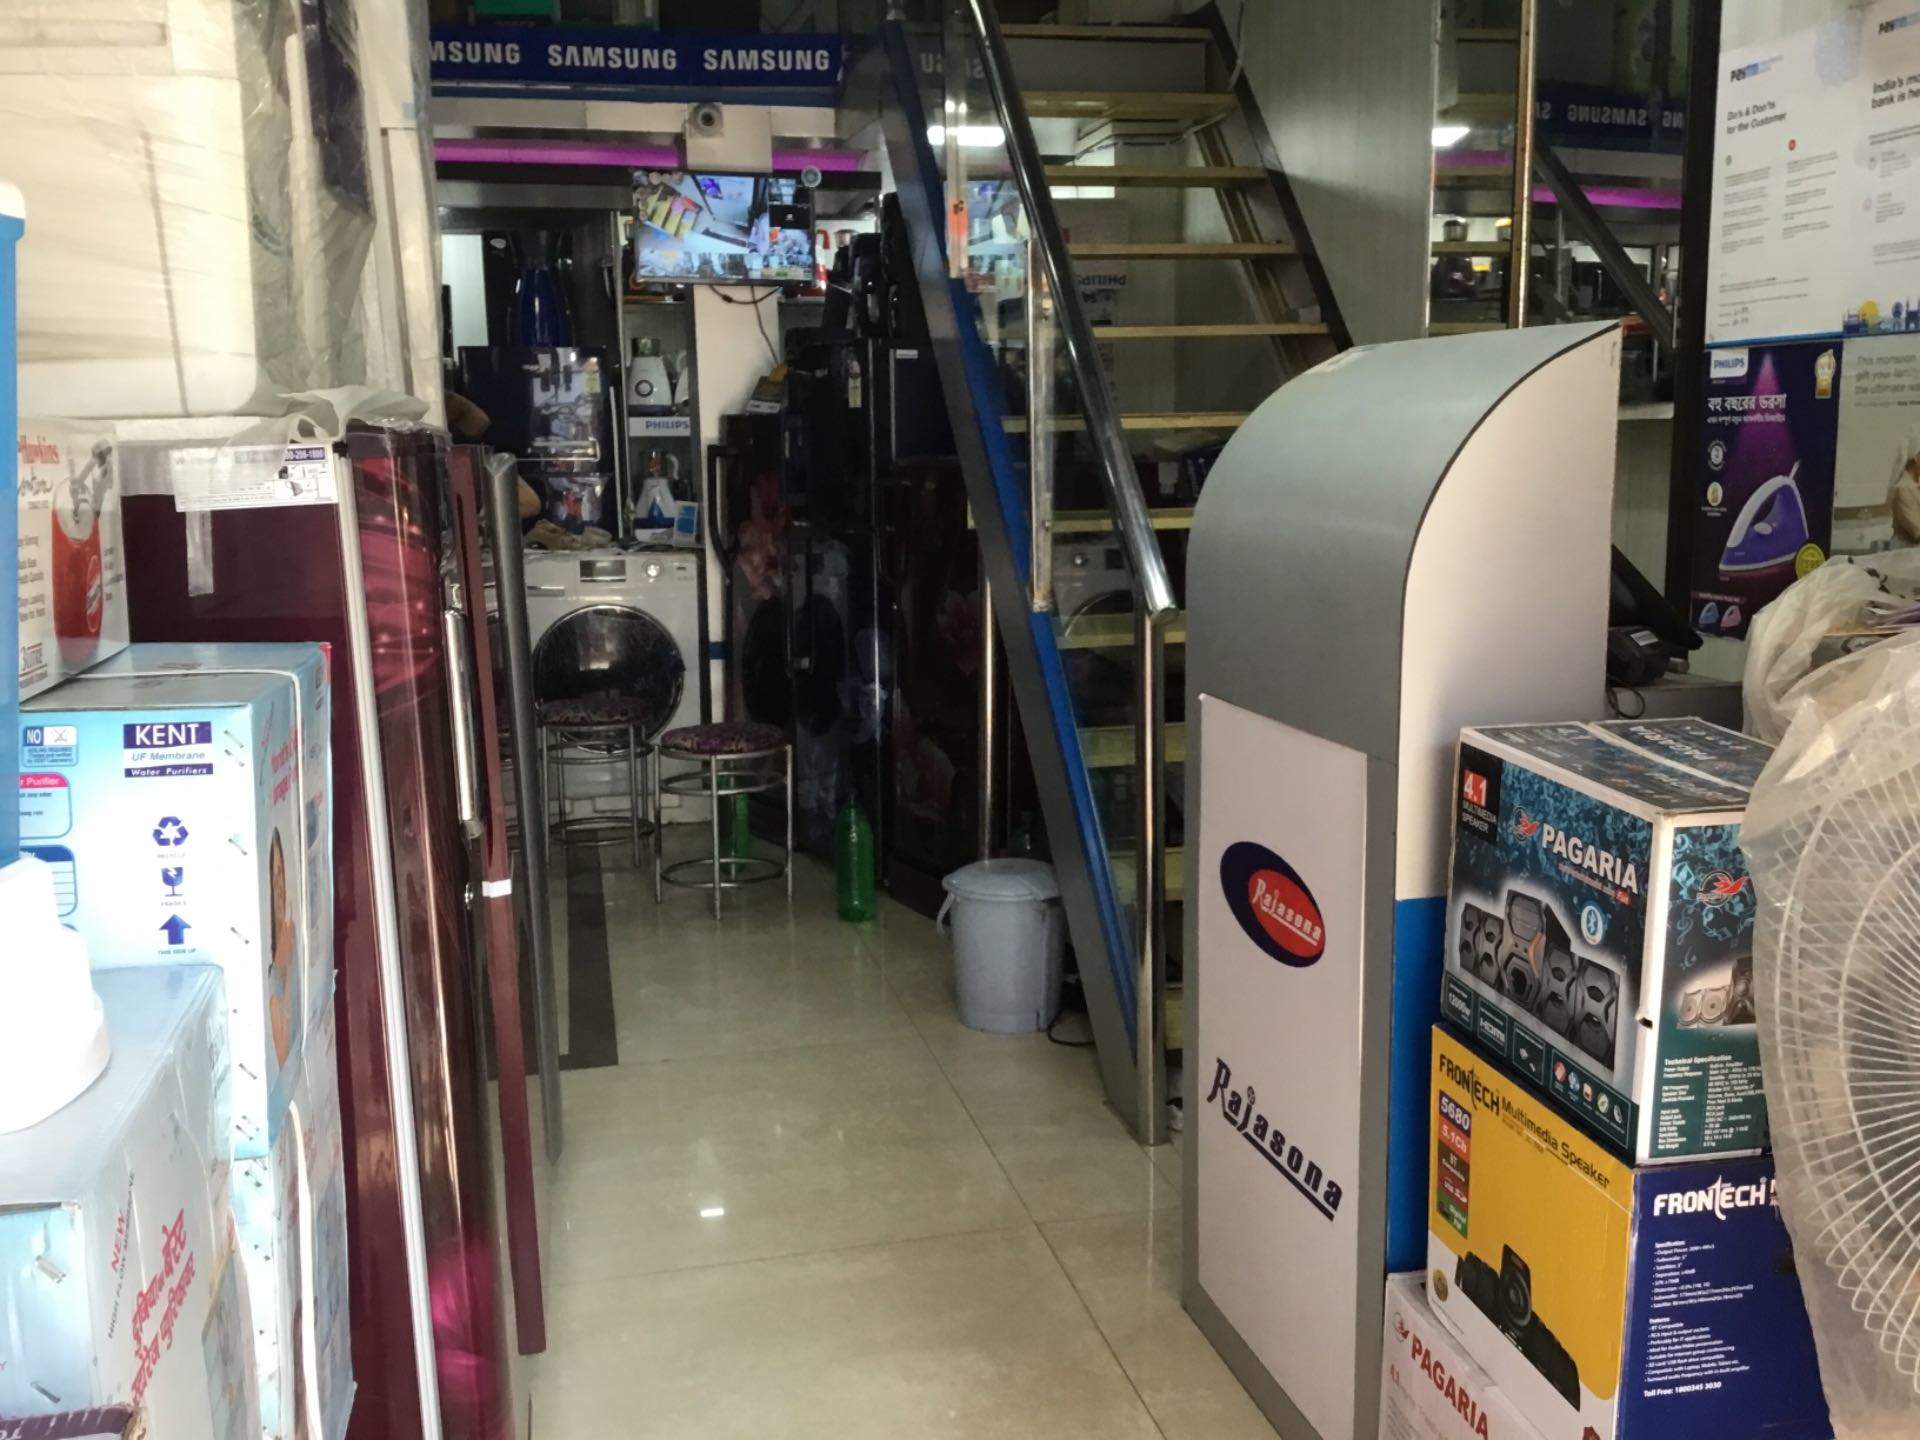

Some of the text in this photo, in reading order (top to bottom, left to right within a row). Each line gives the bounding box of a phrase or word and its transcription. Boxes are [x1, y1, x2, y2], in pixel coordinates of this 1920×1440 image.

[430, 40, 830, 72] MSUNG SAMSUNG SAMSUNG
[1871, 95, 1895, 109] bank
[1751, 112, 1787, 128] Customer
[1713, 357, 1745, 370] PHILIPS
[645, 420, 689, 430] PHILIPS
[26, 728, 42, 744] NO
[135, 723, 200, 746] KENT
[132, 751, 205, 762] UF Membrane
[26, 777, 59, 786] Purifier
[131, 766, 207, 777] Water Purifiers
[1464, 773, 1487, 807] 4.1
[1541, 823, 1639, 894] PAGARIA
[1252, 878, 1322, 944] Rajasona
[1665, 1054, 1732, 1066] Technical Specification
[1439, 1053, 1500, 1116] FRONTECH
[1501, 1096, 1558, 1151] Multimedia
[1561, 1142, 1611, 1189] Speaker
[1441, 1096, 1471, 1131] 5680
[1206, 1057, 1343, 1221] Rajasona
[1653, 1174, 1766, 1220] FRONTECH
[1411, 1333, 1489, 1440] PAGARIA
[1644, 1389, 1656, 1398] Toll
[1657, 1388, 1674, 1396] Free:
[1705, 1381, 1722, 1390] 3030
